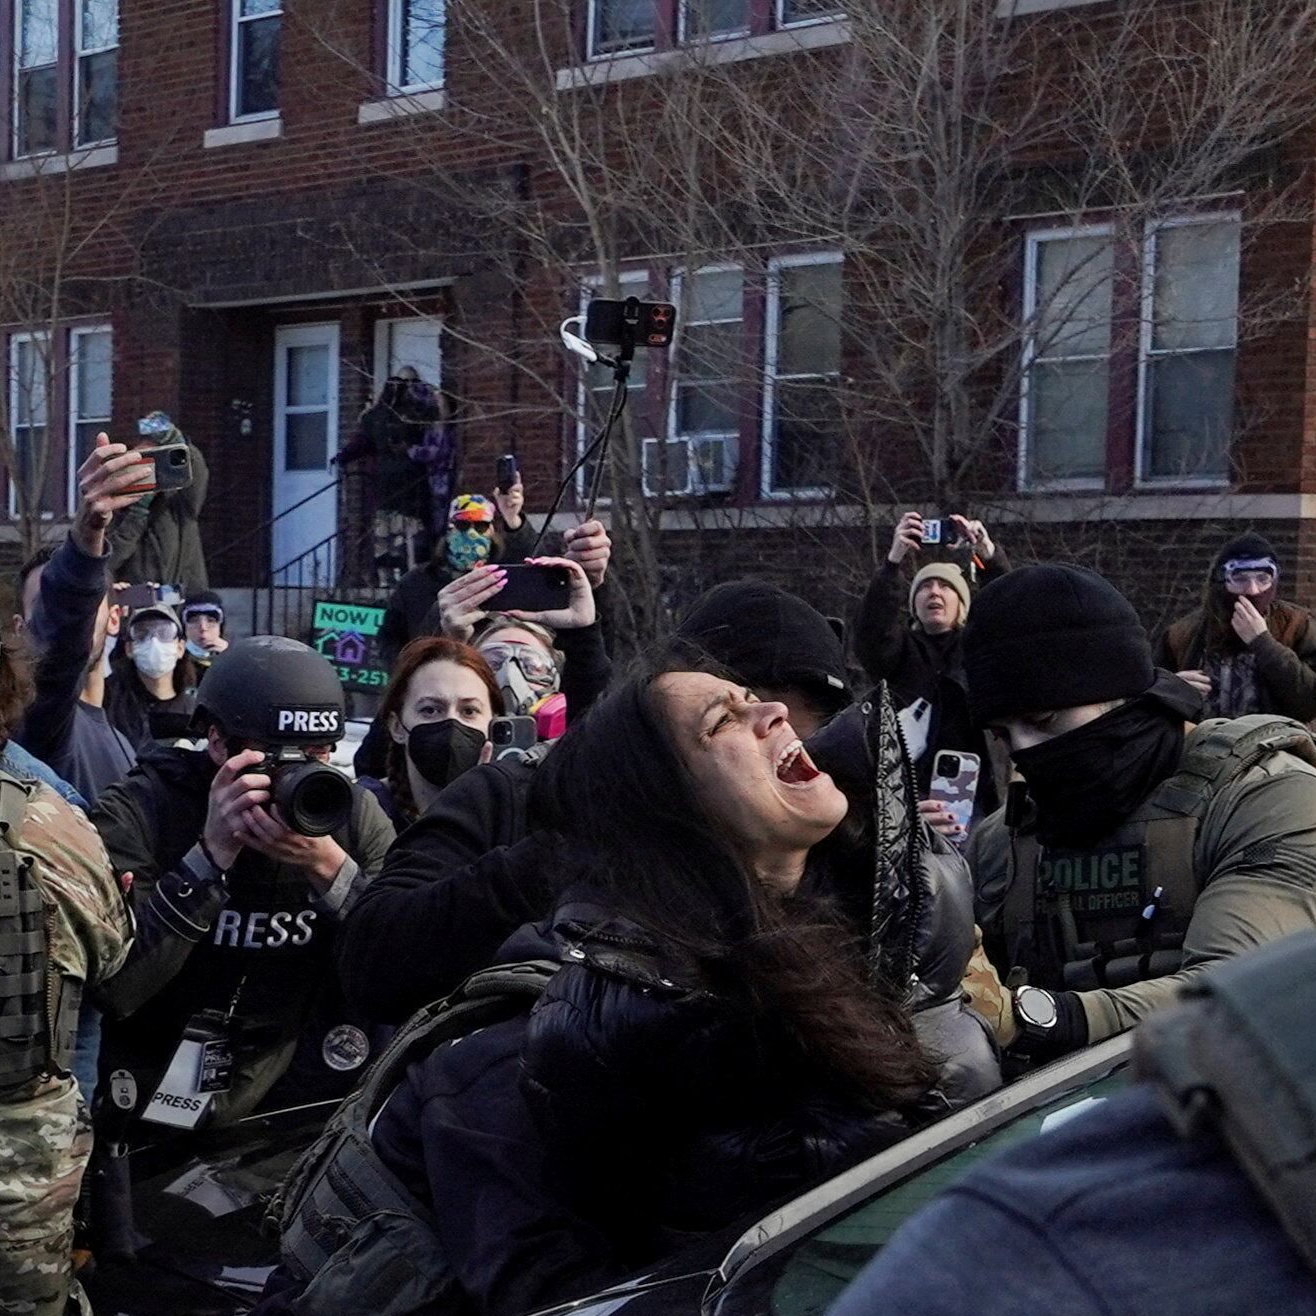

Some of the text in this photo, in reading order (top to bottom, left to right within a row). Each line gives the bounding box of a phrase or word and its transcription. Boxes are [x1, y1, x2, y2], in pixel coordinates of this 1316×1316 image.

[319, 607, 369, 625] NOW
[278, 710, 339, 732] PRESS
[1037, 850, 1140, 892] POLICE
[1087, 891, 1140, 912] OFFICER
[213, 909, 318, 949] RESS
[151, 1092, 202, 1111] PRESS
